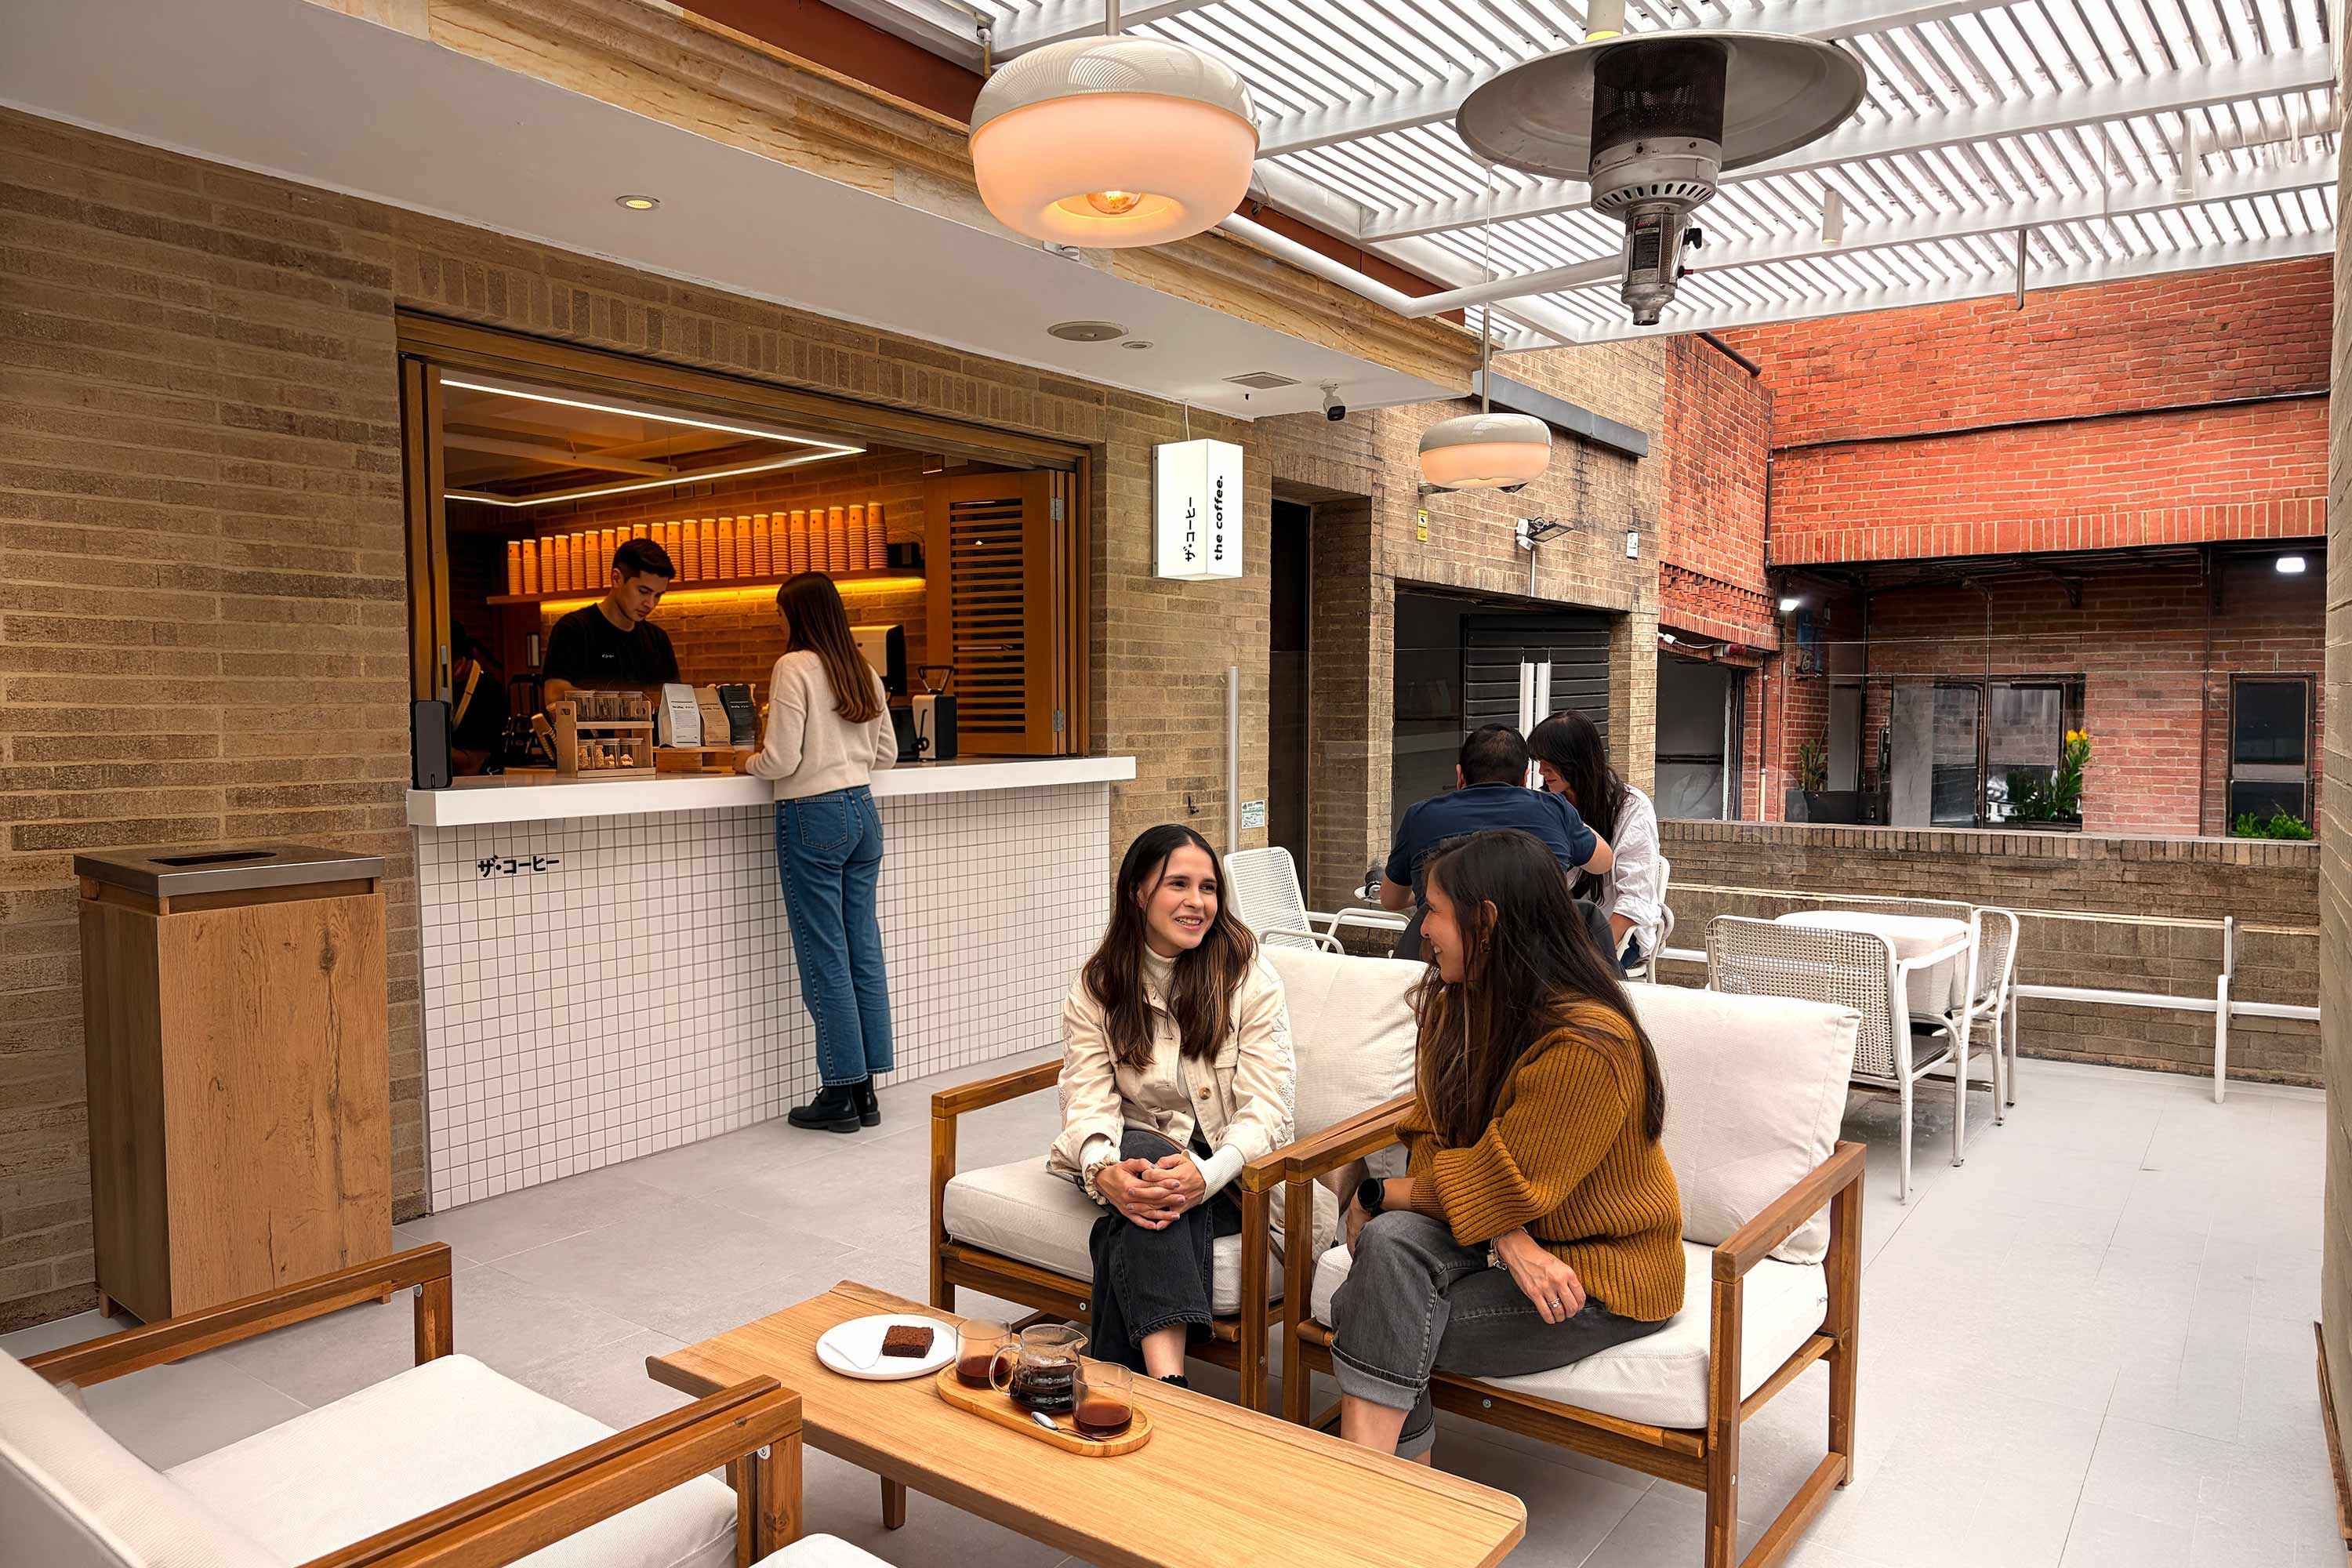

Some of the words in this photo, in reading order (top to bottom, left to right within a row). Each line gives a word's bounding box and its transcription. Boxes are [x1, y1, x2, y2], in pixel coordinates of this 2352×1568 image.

[1214, 476, 1223, 529] coffee.
[1183, 497, 1196, 562] ザ・コーヒー
[1214, 535, 1223, 561] the
[477, 855, 560, 877] ザ・コーヒー
